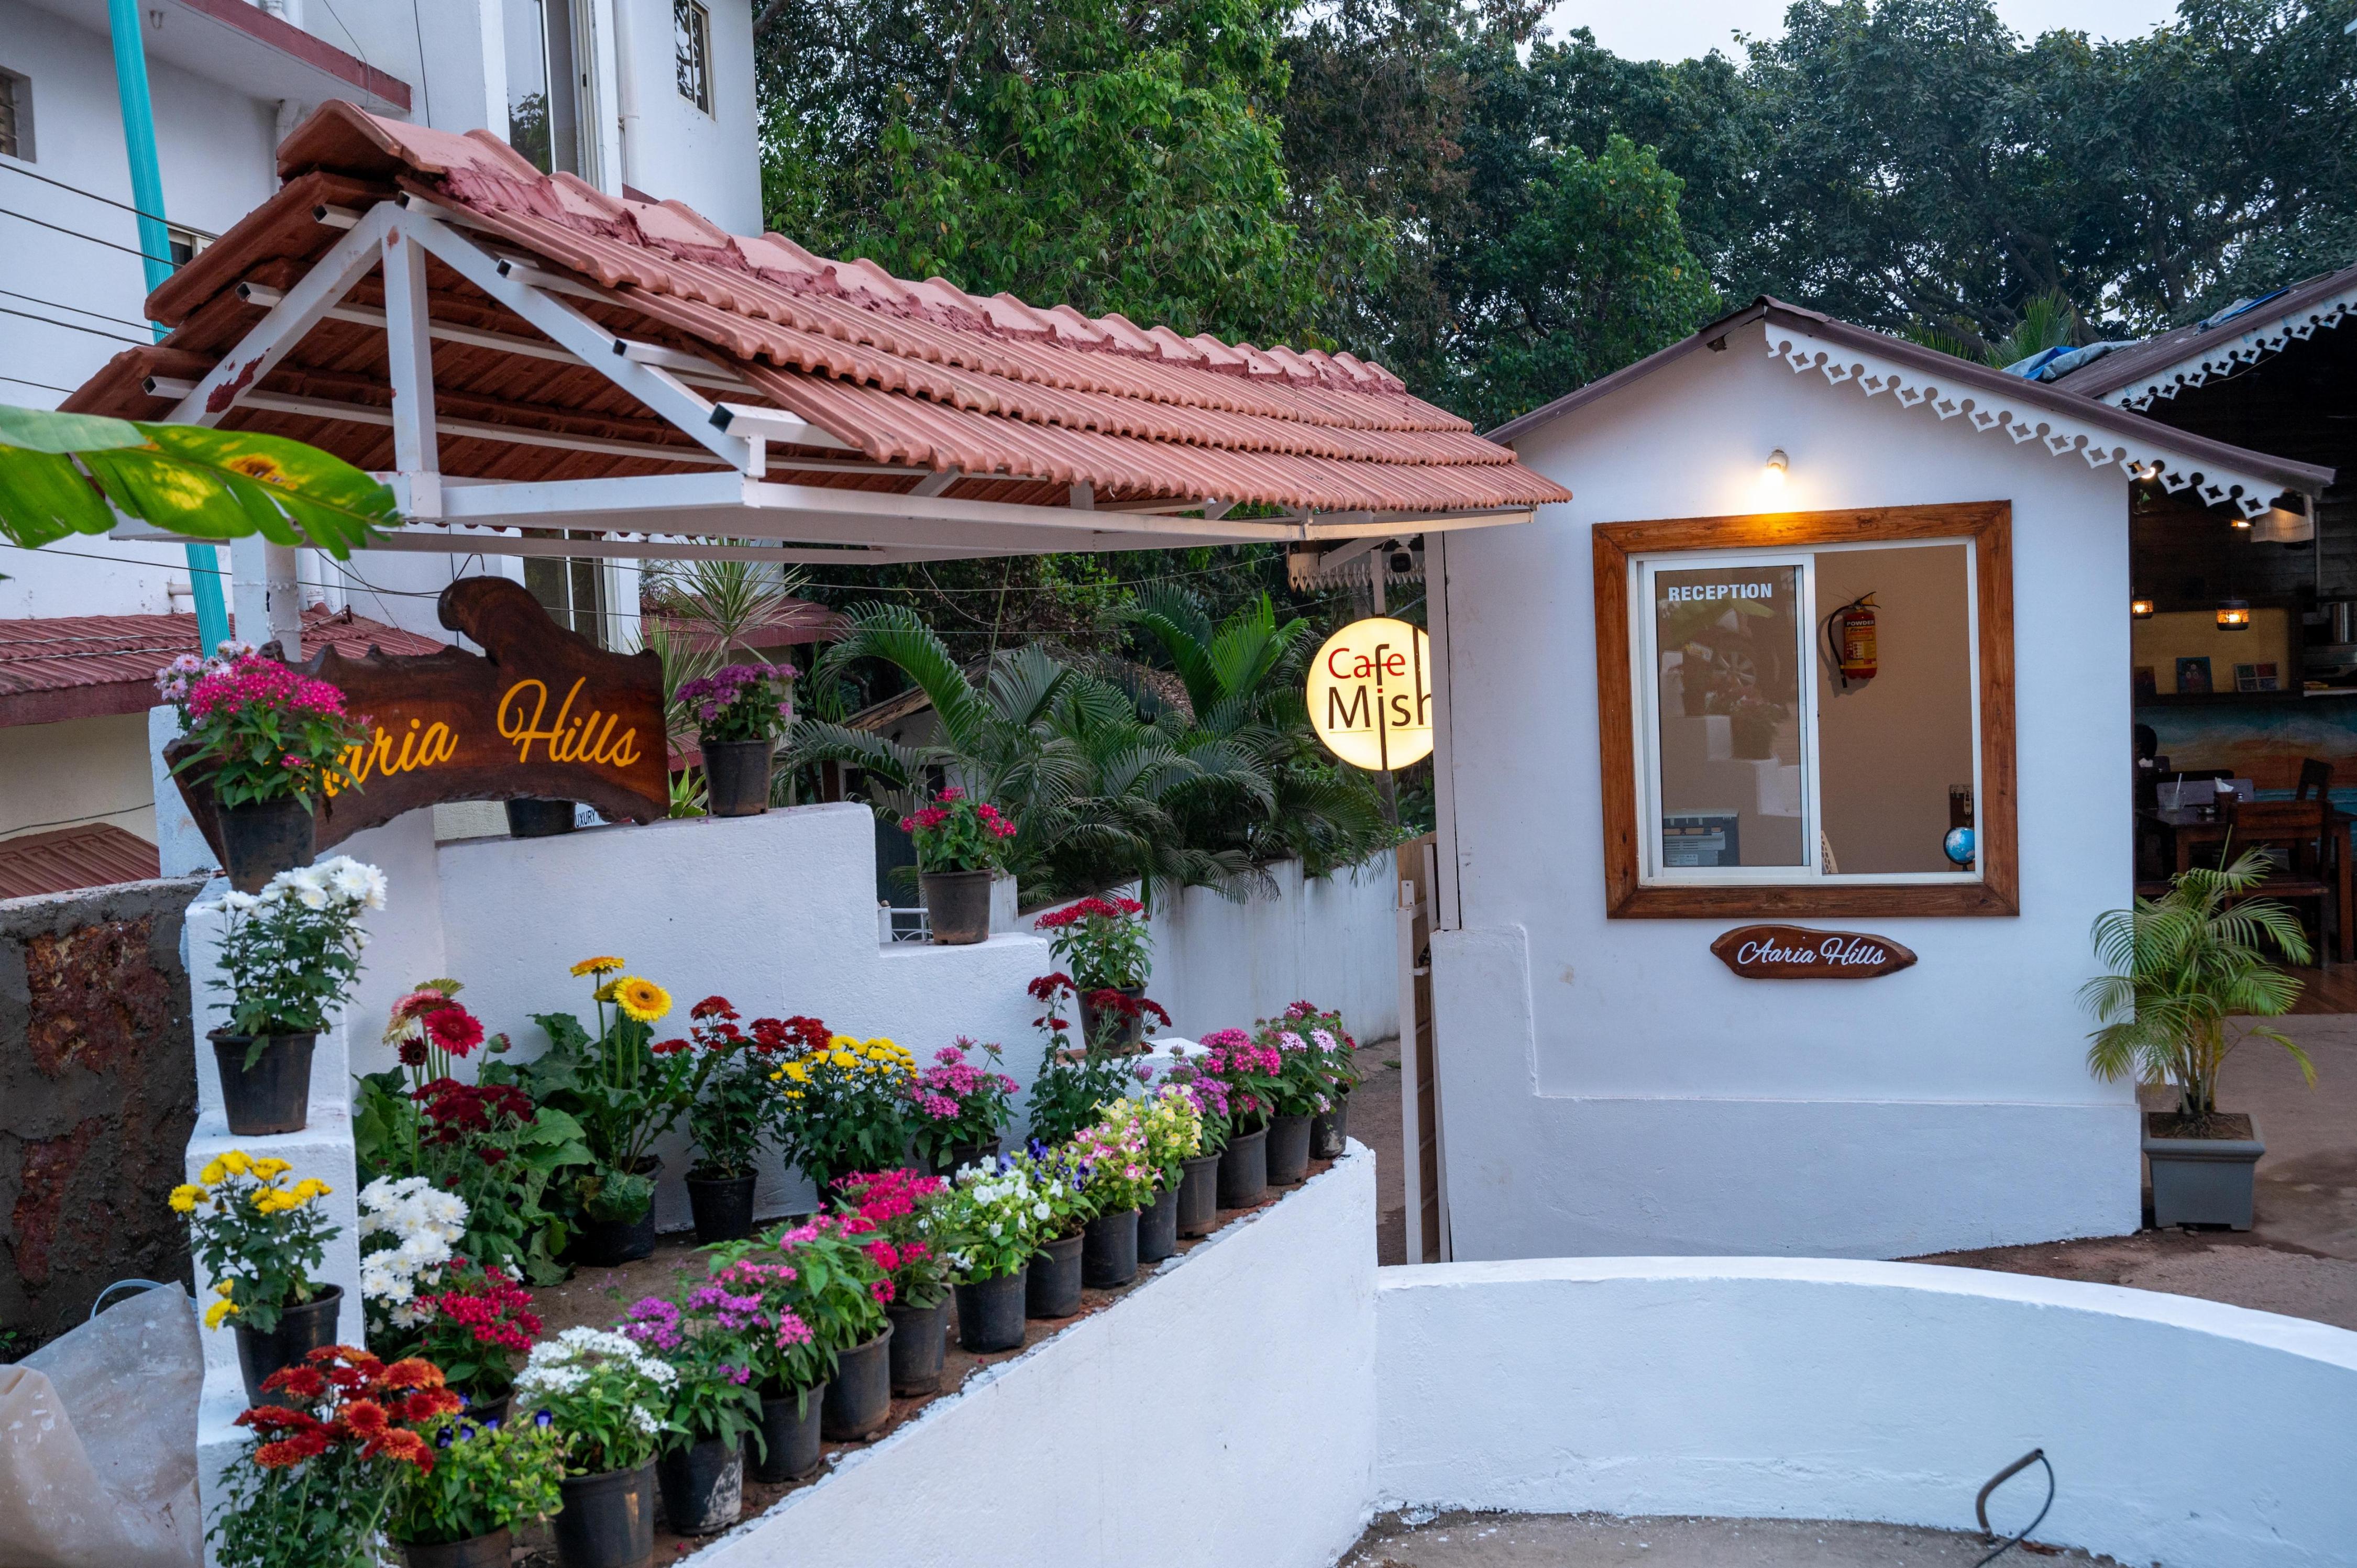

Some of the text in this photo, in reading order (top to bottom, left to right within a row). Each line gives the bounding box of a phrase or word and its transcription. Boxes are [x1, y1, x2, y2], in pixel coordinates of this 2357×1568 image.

[1668, 583, 1772, 601] RECEPTION
[1328, 644, 1405, 686] Cafe
[304, 677, 641, 797] aria Hills
[575, 809, 596, 827] UXURY
[1737, 937, 1886, 966] Aaria Hills
